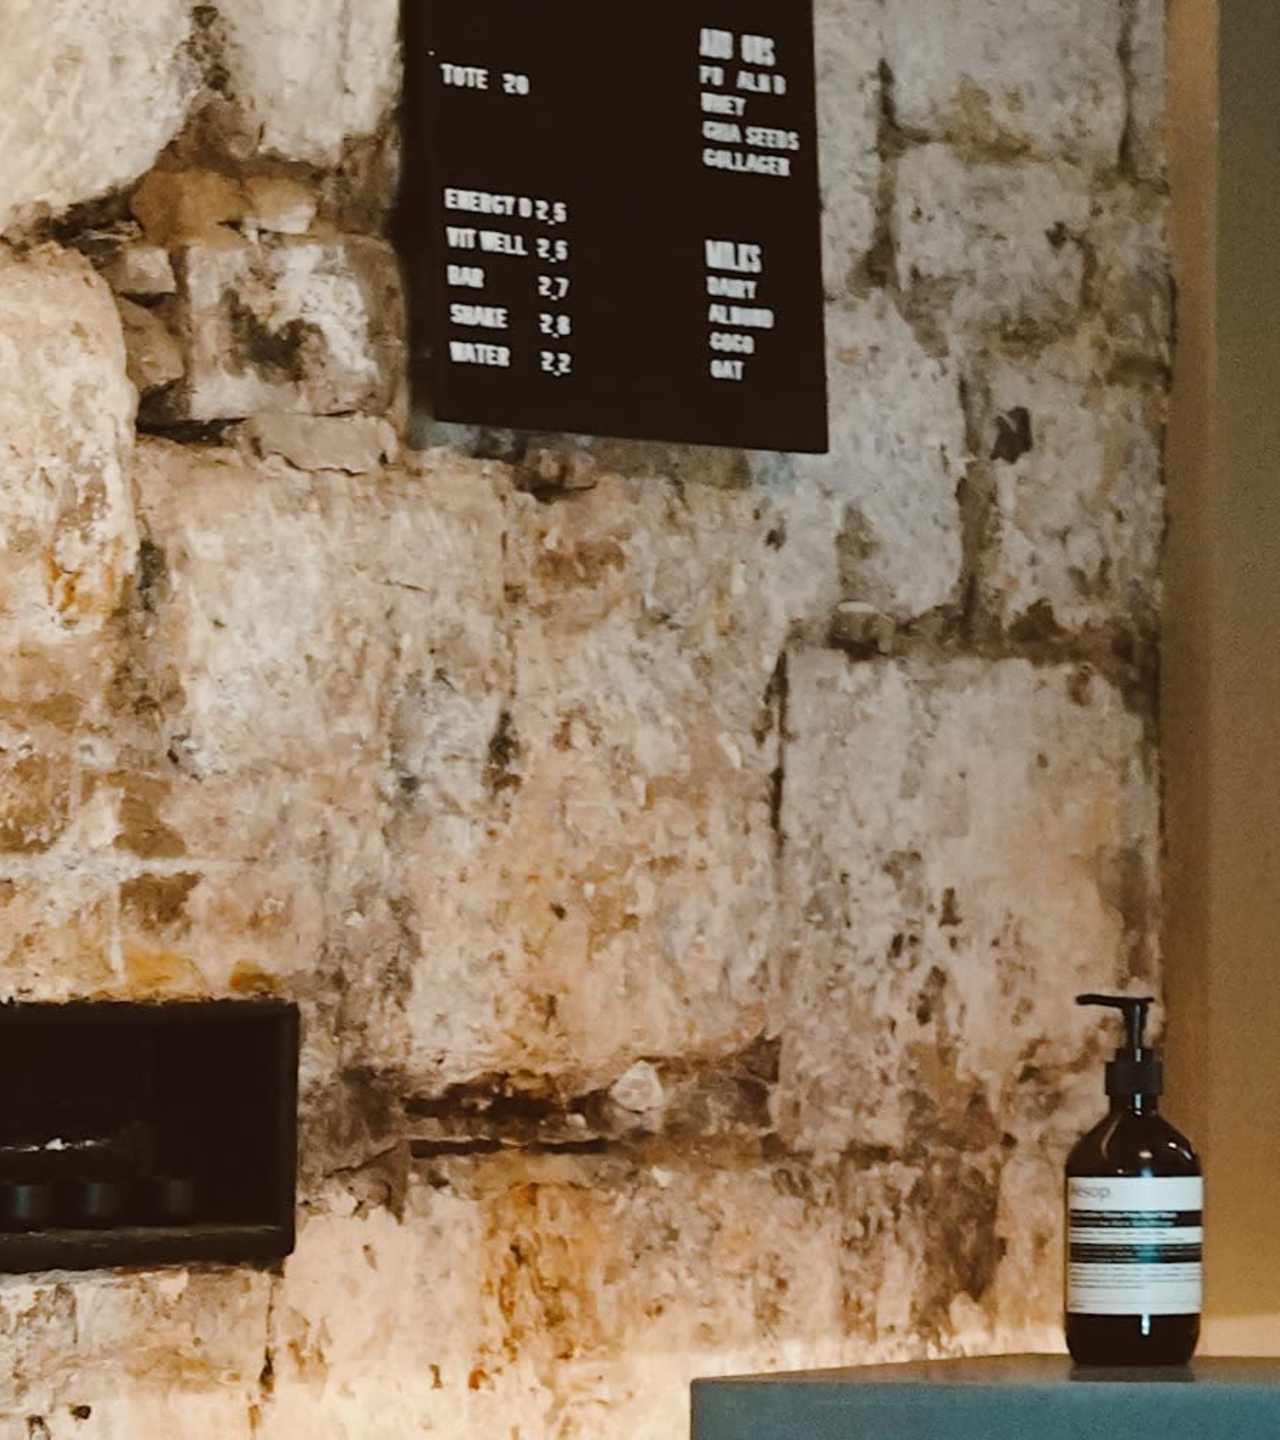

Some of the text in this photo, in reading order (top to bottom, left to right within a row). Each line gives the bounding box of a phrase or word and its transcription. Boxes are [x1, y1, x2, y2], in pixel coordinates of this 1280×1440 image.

[440, 63, 529, 95] TOTE 20
[745, 126, 799, 151] SEEDS
[702, 148, 790, 177] COLLAGEN
[444, 188, 516, 216] ENERGY
[446, 226, 477, 249] VIT
[479, 230, 529, 256] WELL
[447, 264, 484, 288] BAR
[450, 303, 508, 329] SHAKE
[449, 341, 510, 367] WATER
[710, 359, 744, 380] OAT
